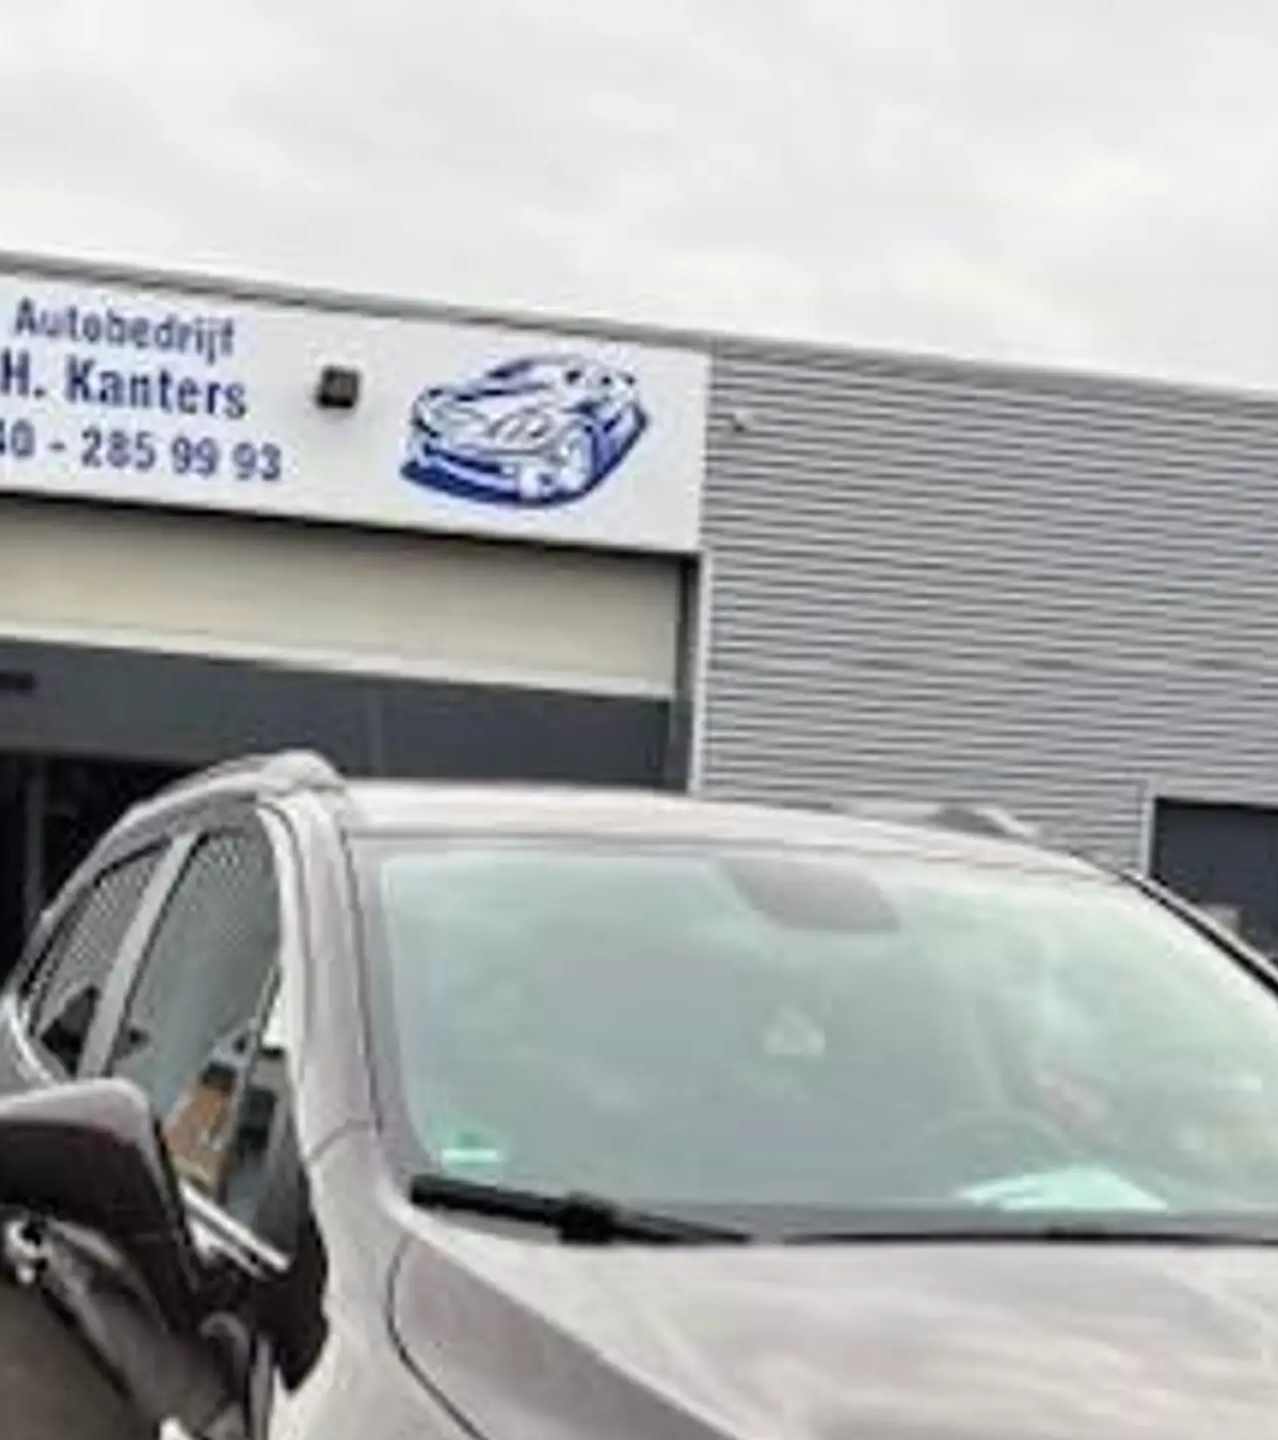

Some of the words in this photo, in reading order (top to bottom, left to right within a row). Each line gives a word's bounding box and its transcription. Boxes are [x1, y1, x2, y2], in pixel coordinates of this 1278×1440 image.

[14, 297, 236, 367] Autobedrijf
[65, 355, 249, 421] Kanters
[81, 425, 157, 473] 285
[170, 435, 220, 479] 99
[232, 441, 283, 483] 93
